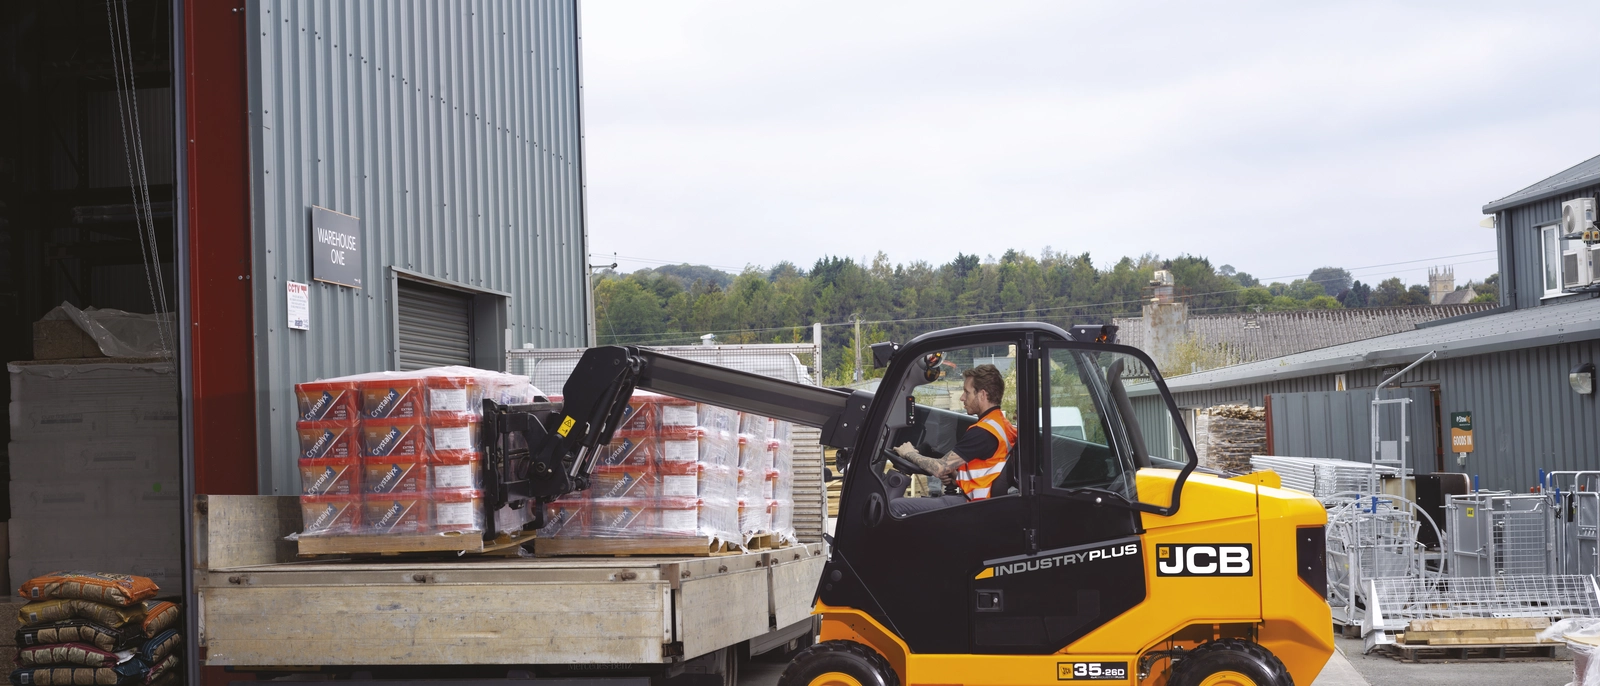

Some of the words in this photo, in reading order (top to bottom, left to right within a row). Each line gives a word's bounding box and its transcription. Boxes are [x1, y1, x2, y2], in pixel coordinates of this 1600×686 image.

[318, 228, 356, 251] WAREHOUSE
[330, 249, 346, 266] ONE
[288, 284, 300, 294] CCTV
[304, 394, 329, 420] Crystalyx
[370, 390, 396, 418] Crystalyx
[306, 432, 330, 458] Crystalyx
[372, 429, 397, 456] Crystalyx
[604, 440, 629, 465] Crystalyx
[1453, 436, 1466, 446] GOODS
[1467, 435, 1472, 445] IN
[308, 469, 332, 495] Crystalyx
[374, 467, 398, 493] Crystalyx
[309, 506, 333, 532] Crystalyx
[374, 504, 399, 530] Crystalyx
[1159, 546, 1250, 574] JCB
